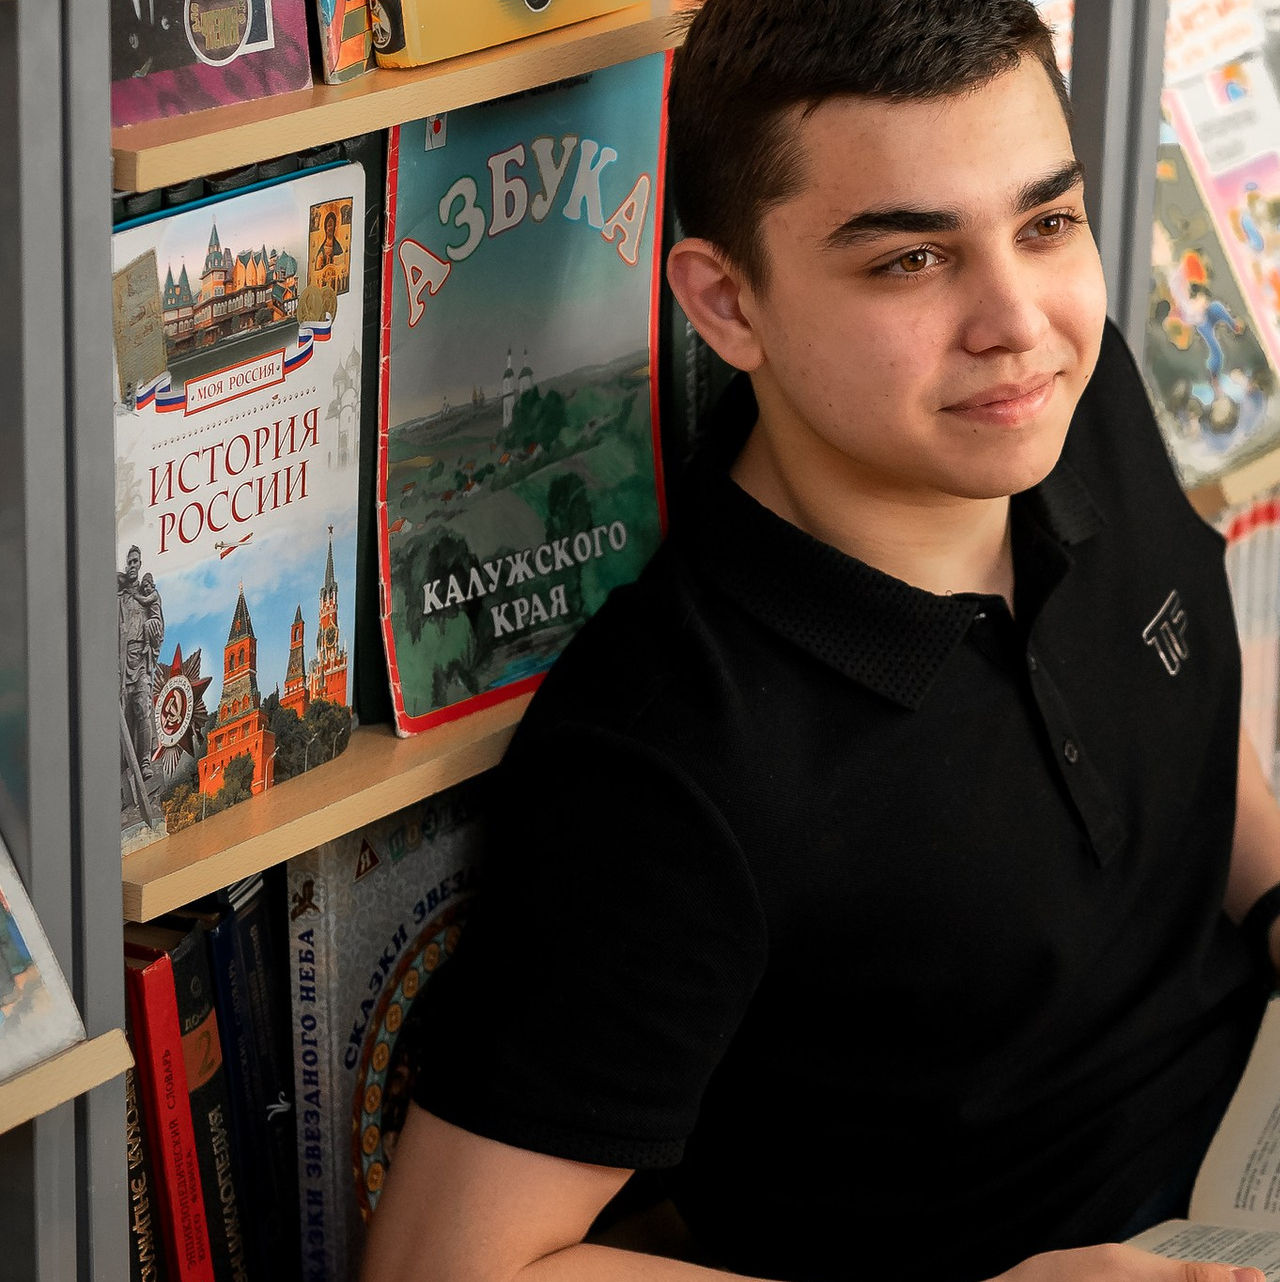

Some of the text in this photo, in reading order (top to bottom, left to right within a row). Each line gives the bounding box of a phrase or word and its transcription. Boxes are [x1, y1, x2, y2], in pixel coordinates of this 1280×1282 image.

[398, 134, 651, 328] АЗБУКА
[196, 361, 276, 402] МОЯ РОССИЯ
[147, 405, 321, 508] ИСТОРИЯ
[157, 459, 309, 556] РОССИИ
[422, 519, 627, 618] КАЛУЖСКОГО
[489, 585, 570, 641] КРАЯ
[358, 847, 374, 874] Я
[300, 927, 316, 1012] НЕБА
[344, 922, 409, 1072] СКАЗКИ
[301, 1016, 323, 1178] ЗВЕЗДНОГО
[161, 1049, 196, 1268] ЭНЦИКЛОПЕДИЧЕСКИЙ СЛОВАРЬ
